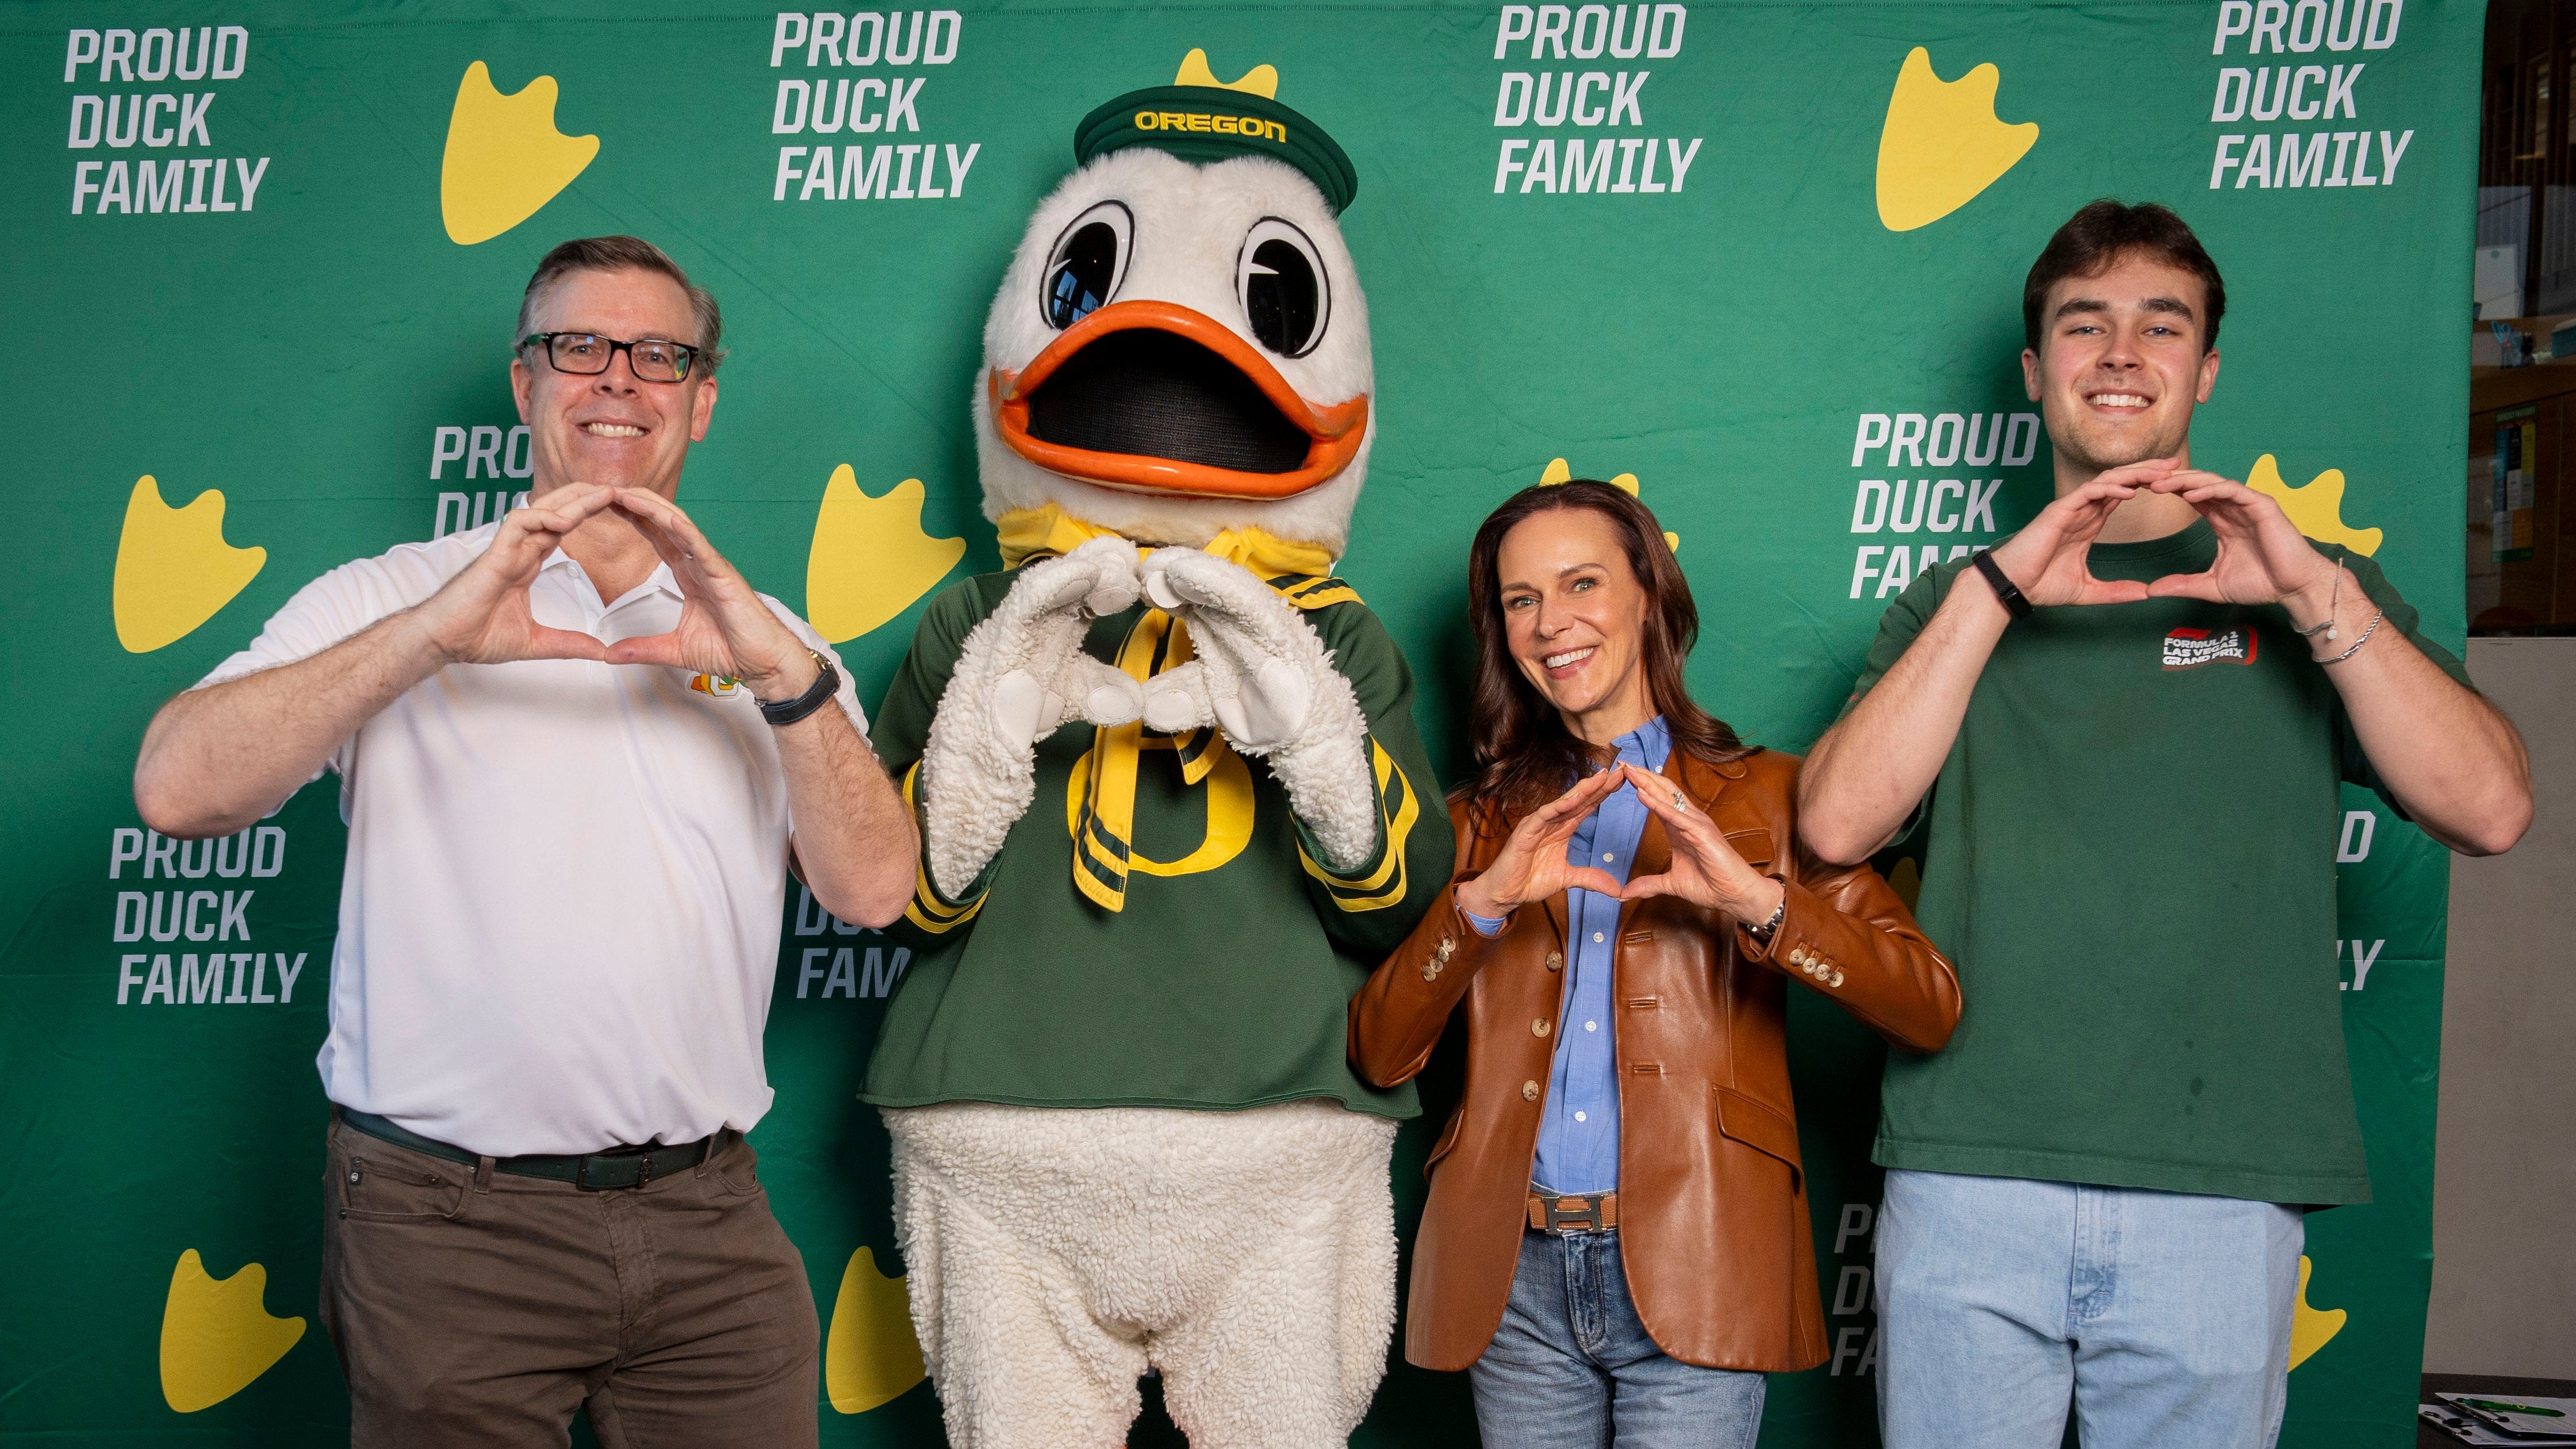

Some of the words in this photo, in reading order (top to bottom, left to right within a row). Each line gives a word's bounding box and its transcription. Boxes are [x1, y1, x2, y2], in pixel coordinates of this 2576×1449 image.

[64, 26, 249, 83] PROUD
[770, 10, 962, 67] PROUD
[1494, 4, 1686, 59] PROUD
[2213, 0, 2403, 55] PROUD
[68, 93, 216, 148] DUCK
[772, 78, 926, 134] DUCK
[1494, 71, 1650, 126] DUCK
[2211, 64, 2366, 122] DUCK
[1134, 111, 1287, 143] OREGON
[71, 158, 270, 214] FAMILY
[773, 143, 981, 201] FAMILY
[1494, 138, 1703, 194] FAMILY
[2209, 129, 2414, 189] FAMILY
[430, 425, 534, 480] PRO
[1851, 413, 2040, 467] PROUD
[1850, 479, 2003, 534] DUCK
[2163, 647, 2191, 657] LAS
[2192, 639, 2238, 656] VEGAS
[2163, 655, 2211, 665] GRAND
[2211, 647, 2244, 660] PRIX
[2164, 635, 2228, 649] FORMULA
[109, 826, 286, 879] PROUD
[113, 890, 255, 942] DUCK
[117, 953, 308, 1005] FAMILY
[796, 947, 911, 999] FAM
